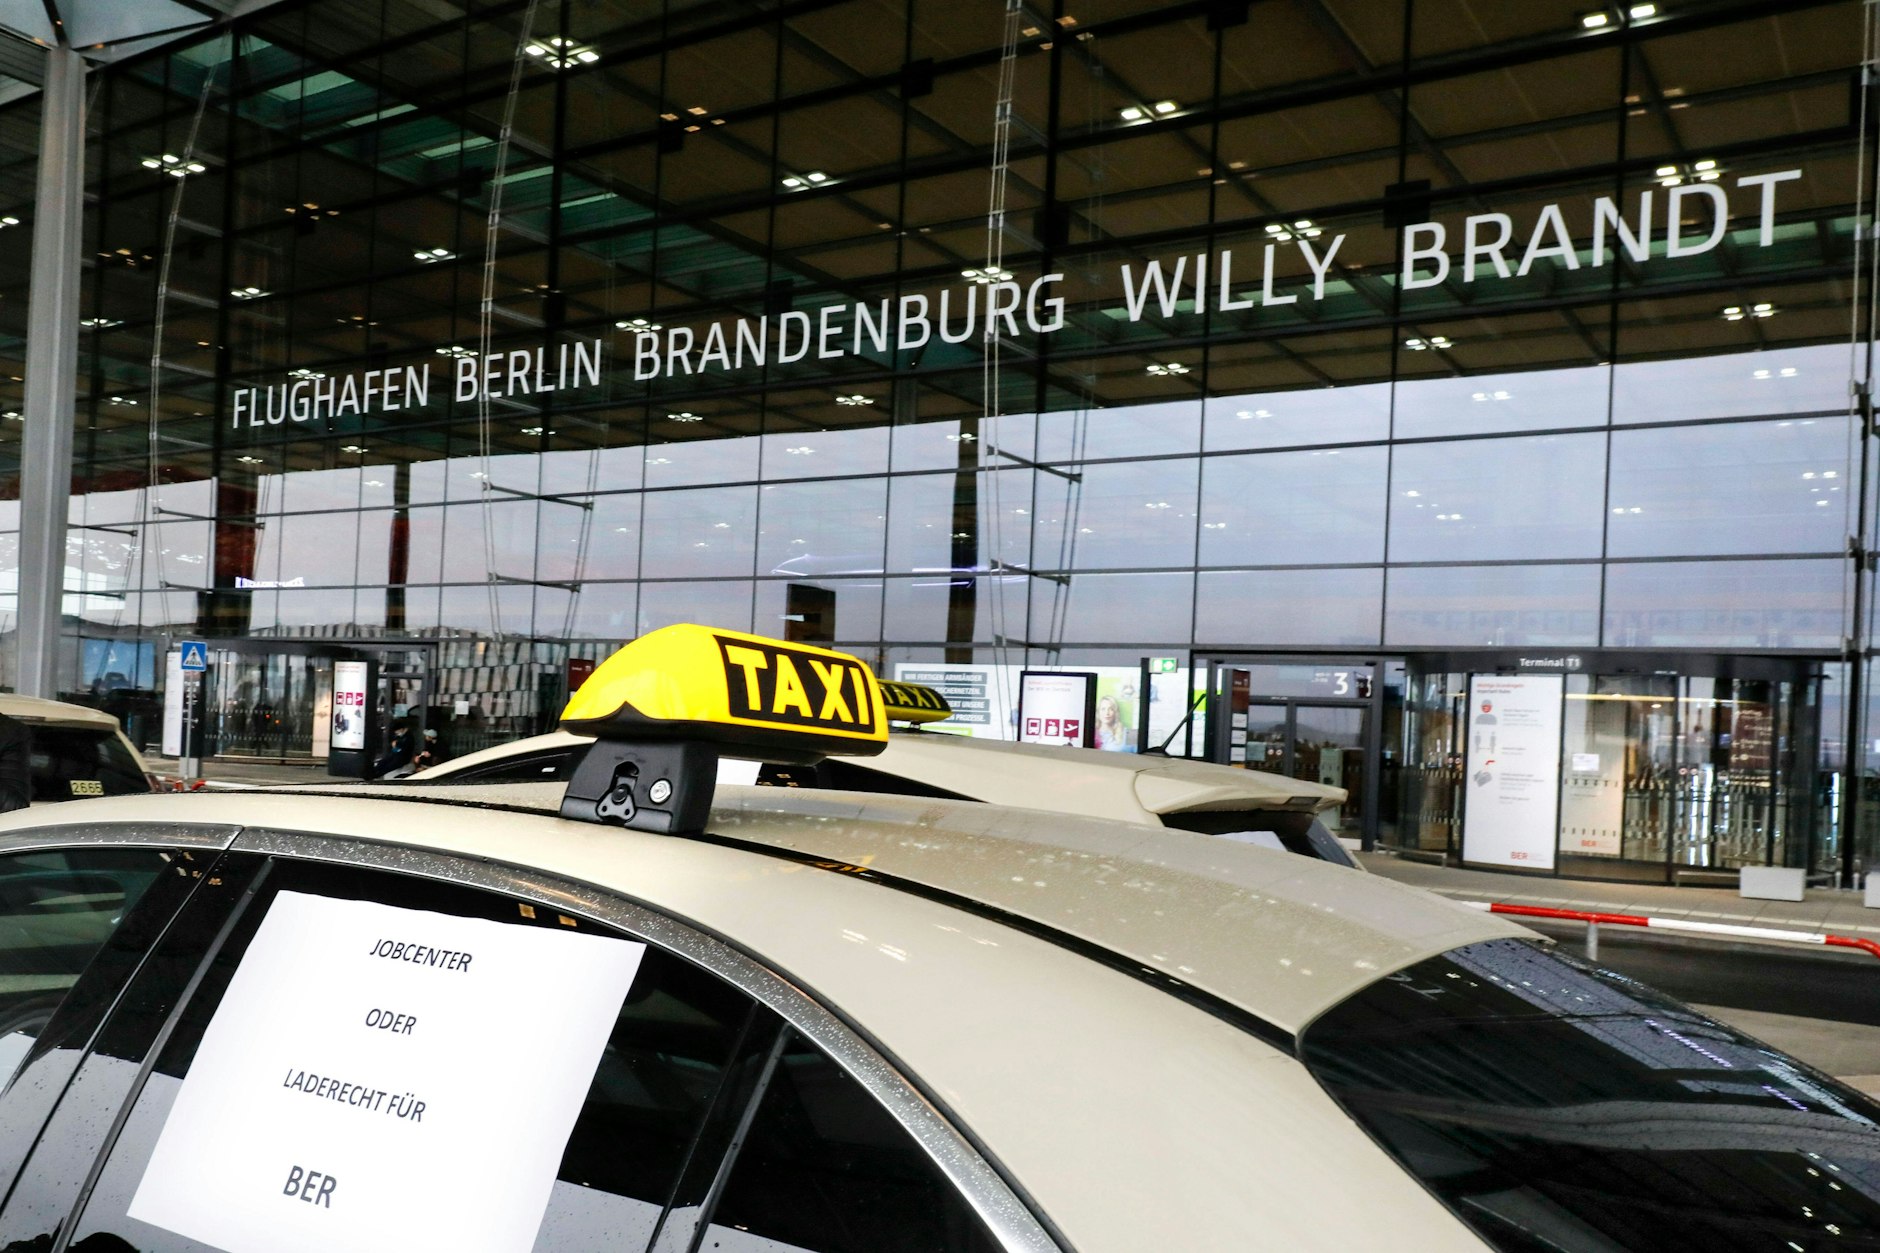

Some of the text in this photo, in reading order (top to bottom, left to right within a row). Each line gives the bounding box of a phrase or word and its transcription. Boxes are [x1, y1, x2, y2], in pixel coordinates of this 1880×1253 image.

[232, 168, 1803, 430] FLUGHAFEN BERLIN BRANDENBURG WILLY BRANDT
[1519, 657, 1580, 667] Terminal T1
[725, 644, 870, 725] TAXI
[1333, 672, 1349, 695] 3
[1510, 851, 1528, 860] BER
[369, 938, 473, 973] JOBCENTER
[365, 1008, 417, 1036] ODER
[283, 1068, 426, 1123] LADERECHT FÜR
[283, 1165, 338, 1209] BER
